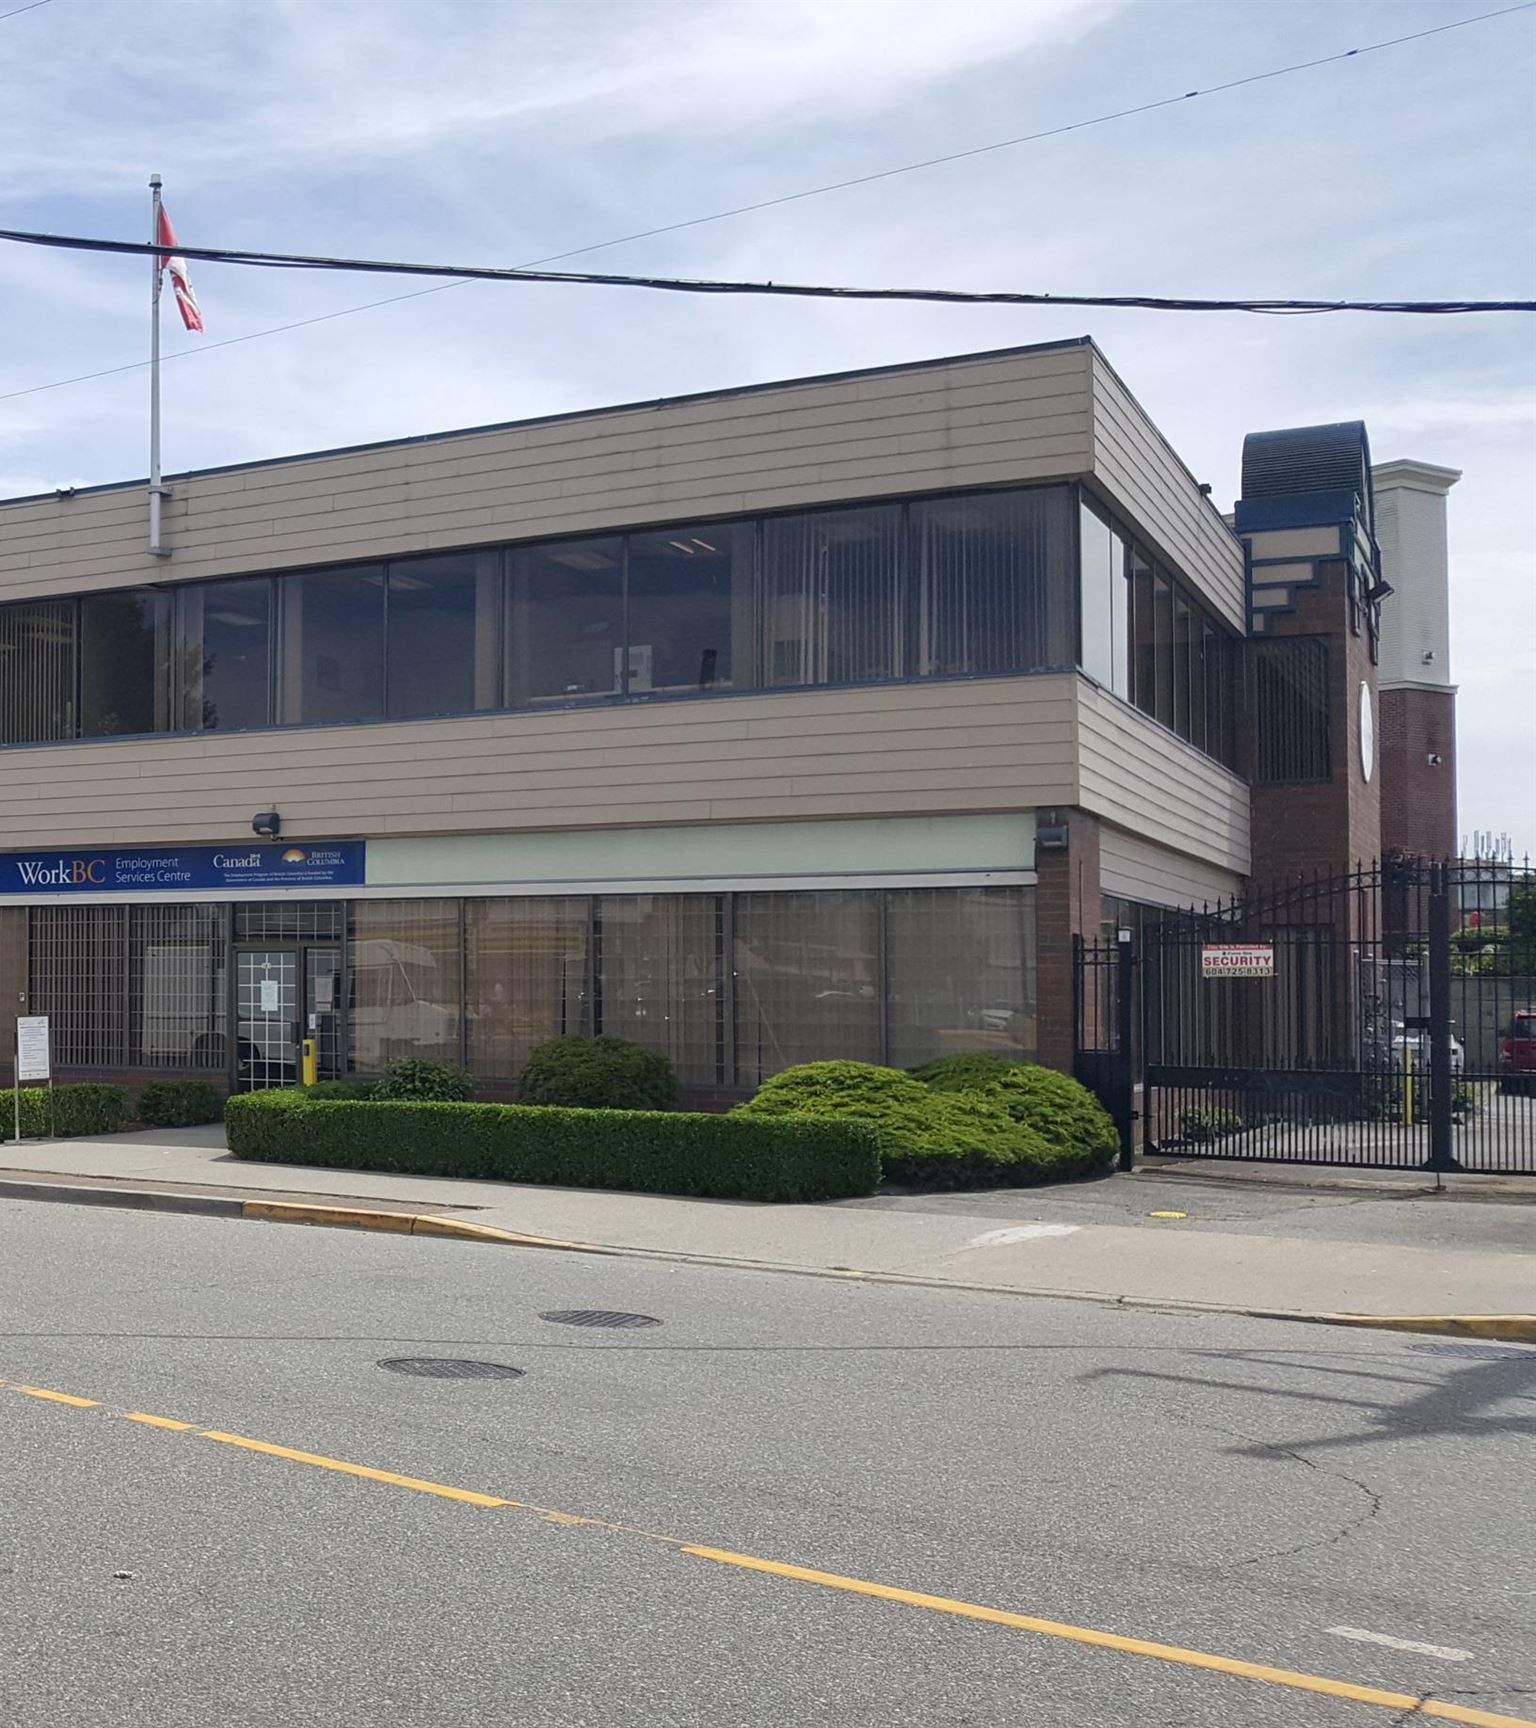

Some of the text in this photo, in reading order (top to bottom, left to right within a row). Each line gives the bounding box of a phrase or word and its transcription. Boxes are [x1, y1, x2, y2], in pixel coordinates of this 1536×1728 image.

[213, 854, 261, 868] Canada
[311, 852, 341, 860] BRITISH
[115, 857, 179, 870] Employment
[16, 860, 106, 885] WorkBC
[115, 870, 191, 884] Services Centre
[1204, 956, 1271, 966] SECURITY
